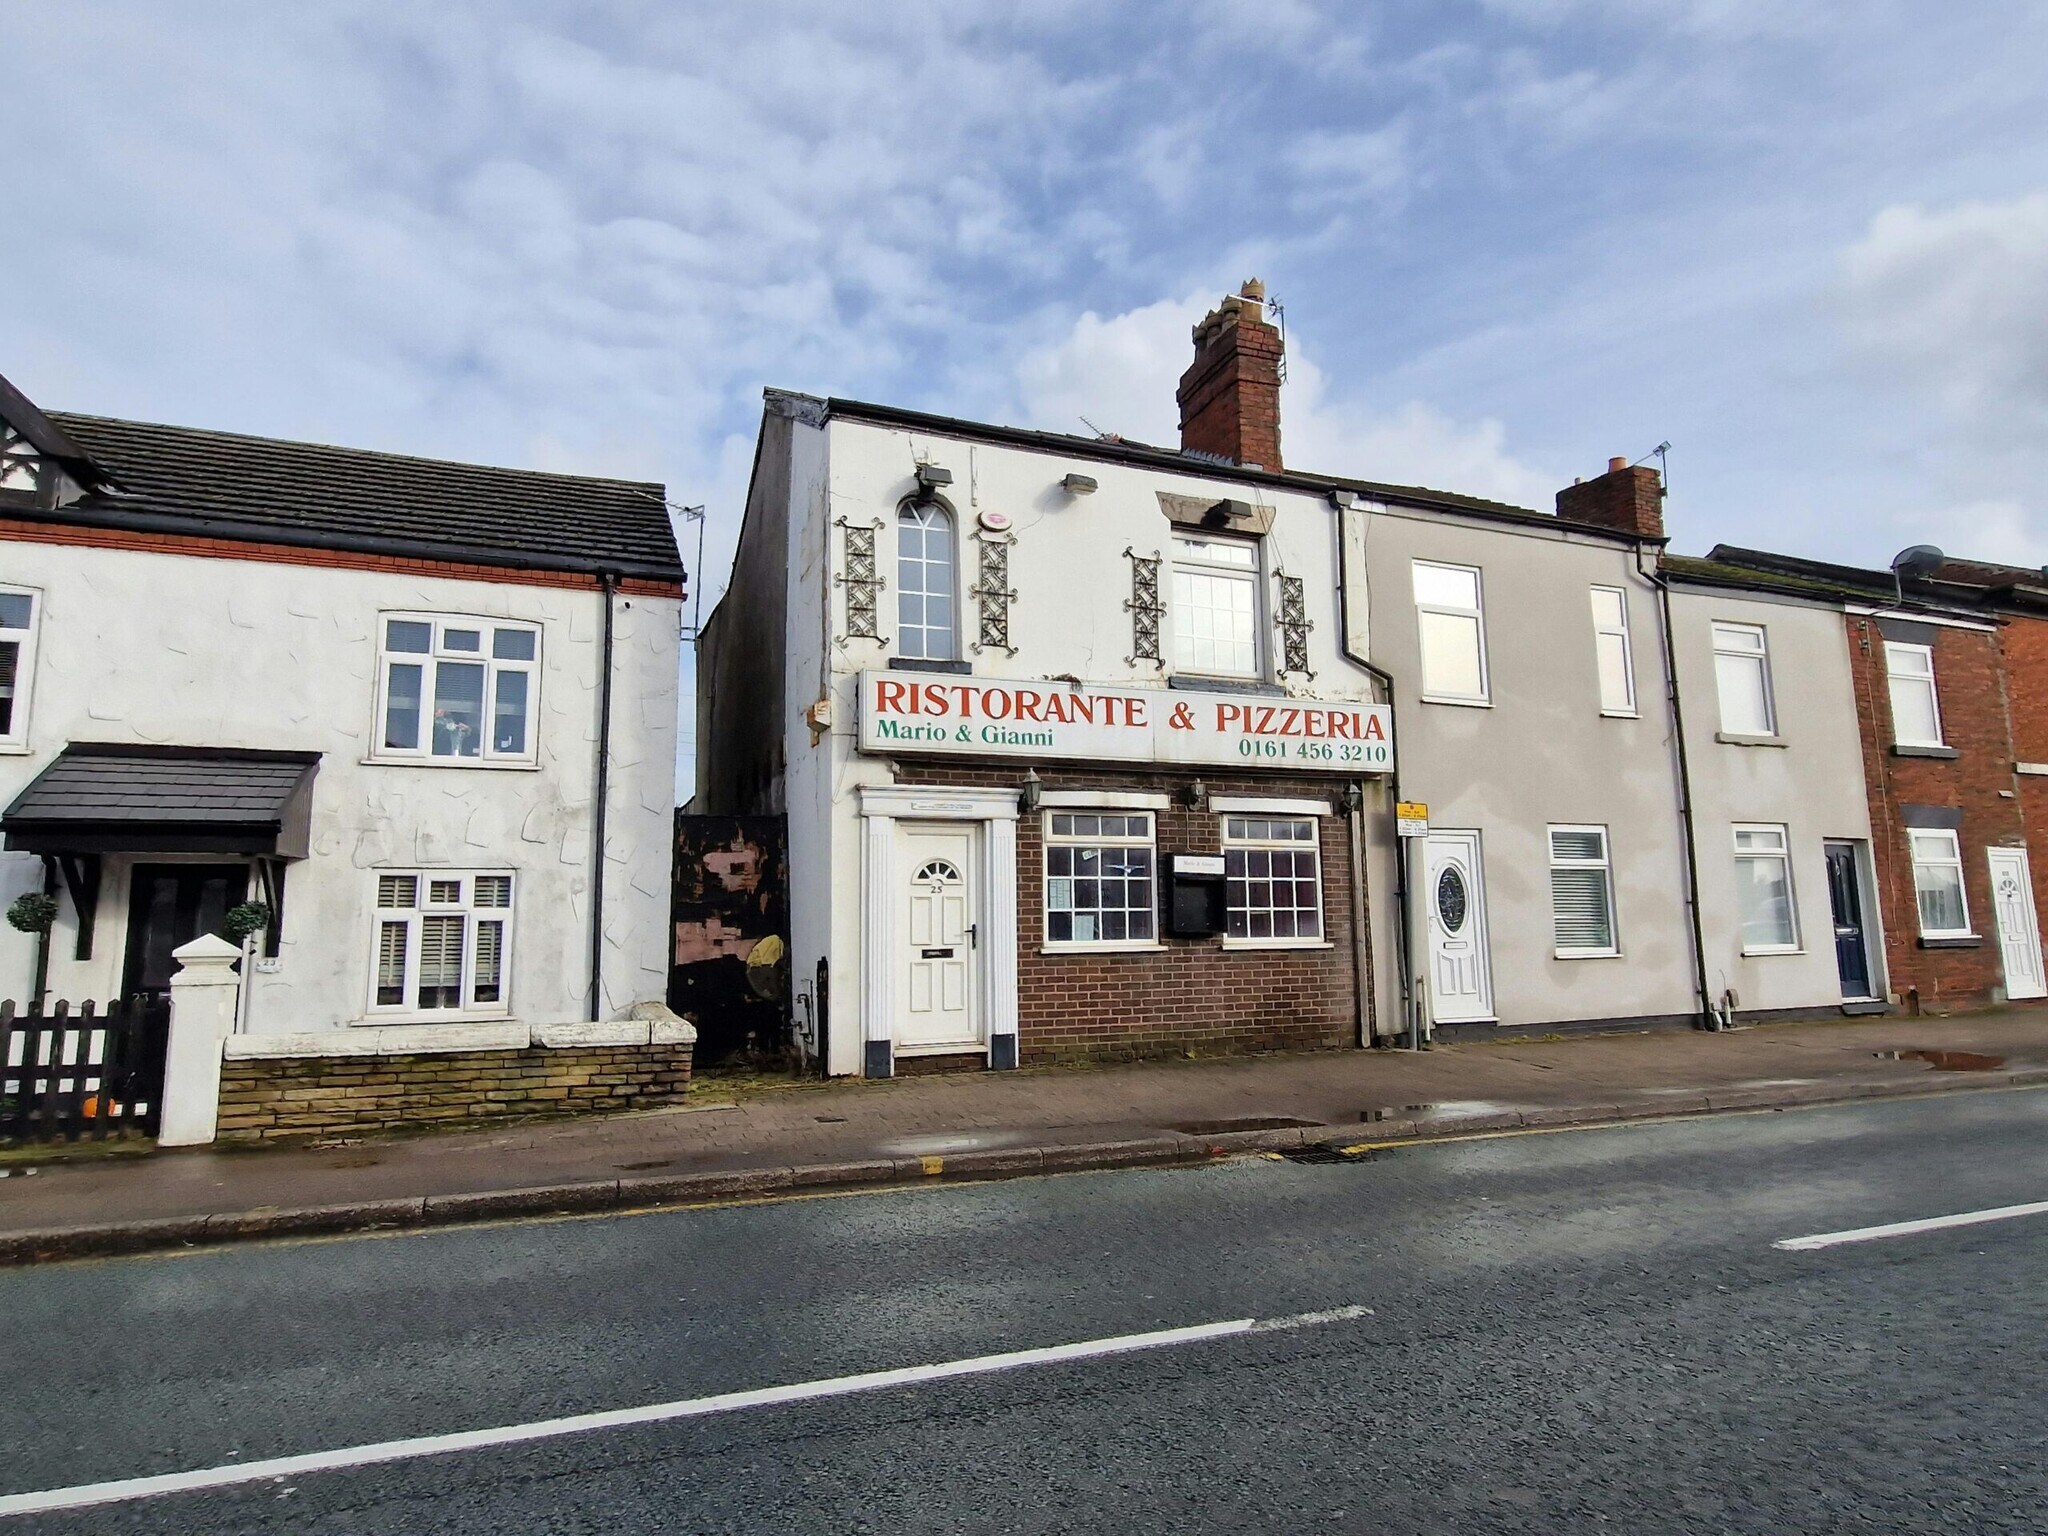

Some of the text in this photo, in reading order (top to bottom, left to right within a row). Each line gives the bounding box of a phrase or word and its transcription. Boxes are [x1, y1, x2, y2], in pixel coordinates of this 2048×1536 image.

[875, 680, 1386, 741] RISTORANTE & PIZZERIA
[876, 719, 1054, 747] Mario & Gianni
[1238, 738, 1387, 763] 0161 456 3210
[931, 885, 943, 894] 25
[263, 959, 276, 967] 23
